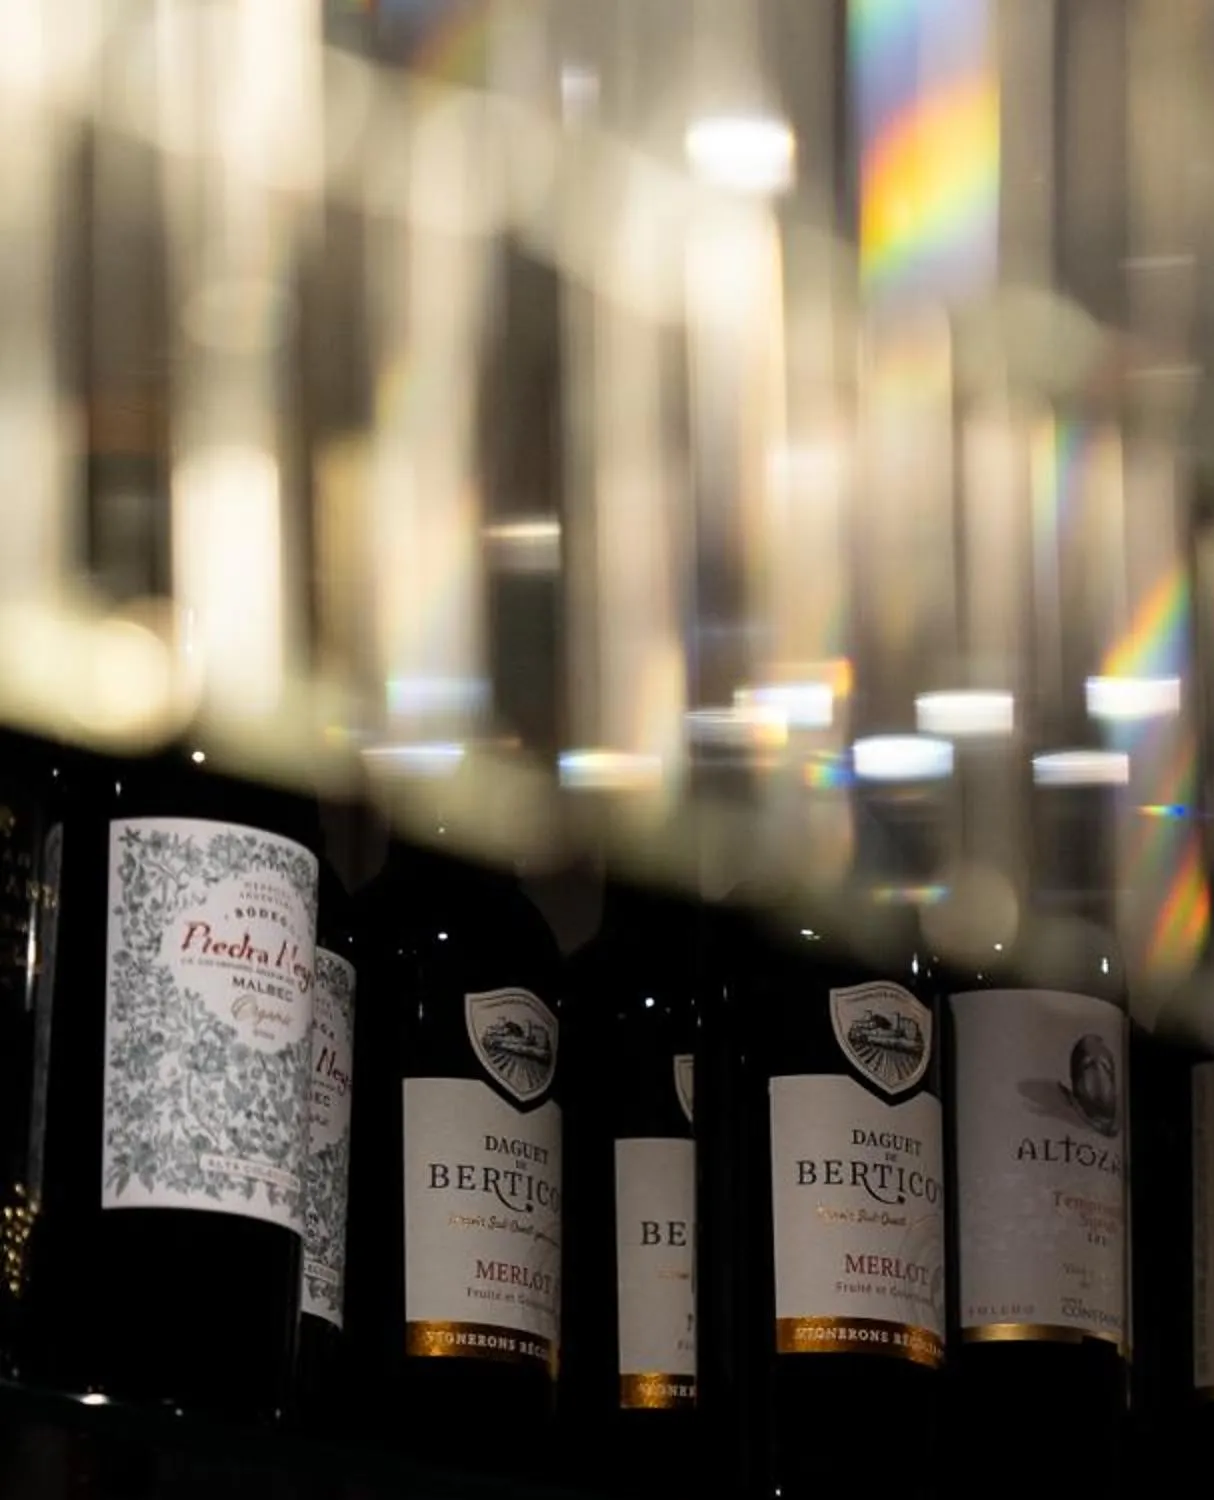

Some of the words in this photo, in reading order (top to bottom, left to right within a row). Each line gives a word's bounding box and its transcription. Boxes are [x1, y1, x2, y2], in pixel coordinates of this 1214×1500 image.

[234, 906, 296, 934] BODEG
[181, 920, 269, 966] Piedra
[232, 975, 294, 1003] MALBEC
[484, 1134, 549, 1166] DAGUET
[851, 1129, 922, 1157] DAGUET
[795, 1159, 939, 1206] BERTICO
[640, 1219, 690, 1248] BE
[475, 1258, 553, 1296] MERLOT
[845, 1253, 929, 1287] MERLOT
